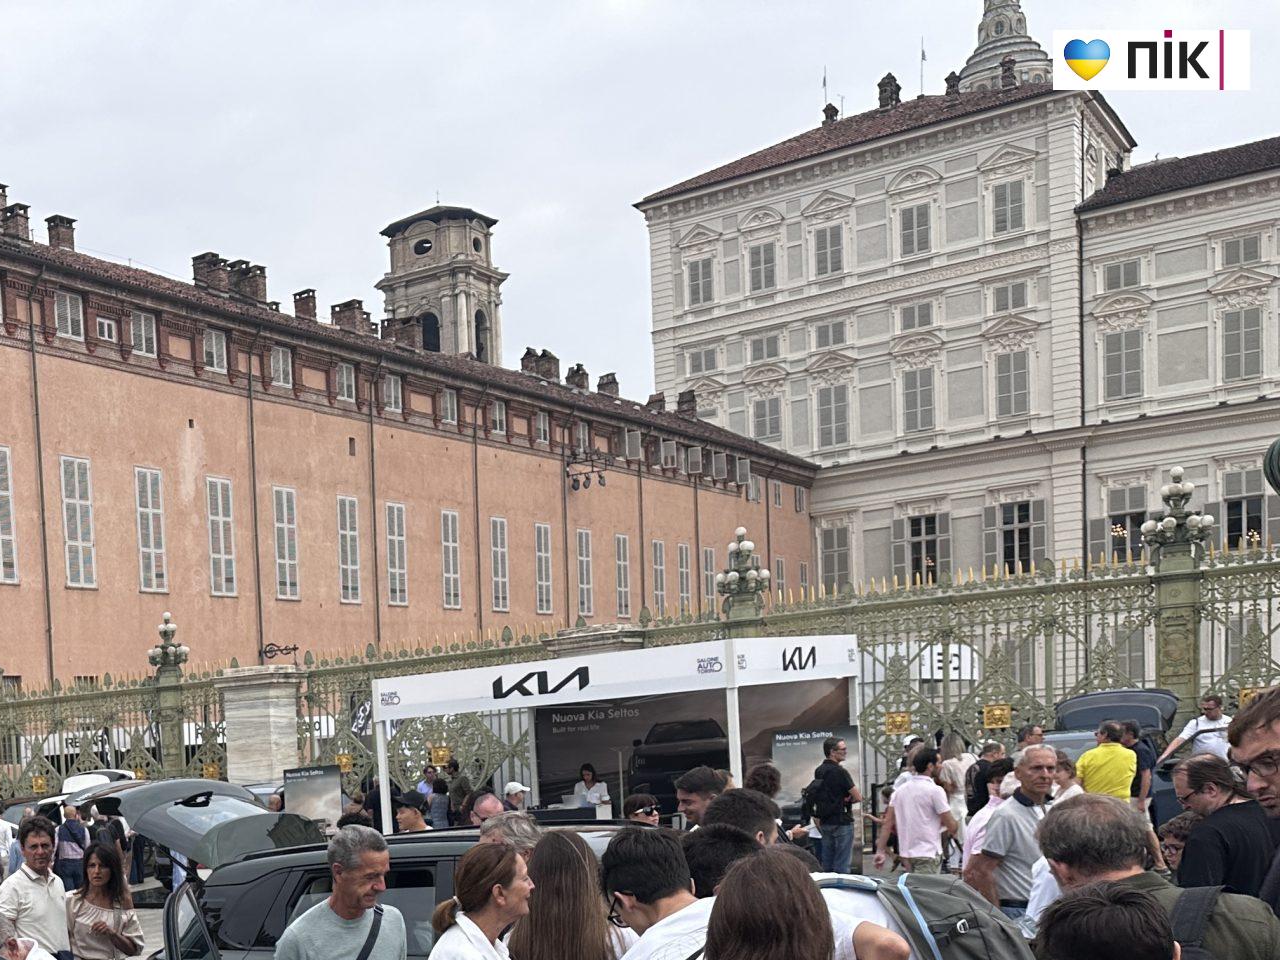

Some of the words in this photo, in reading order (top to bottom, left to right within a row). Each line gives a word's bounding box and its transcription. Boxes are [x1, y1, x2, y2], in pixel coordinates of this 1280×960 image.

[782, 646, 817, 671] KIA
[492, 666, 590, 700] KIA
[552, 711, 585, 723] Nuova
[587, 709, 605, 720] Kia
[607, 708, 640, 719] Seltos
